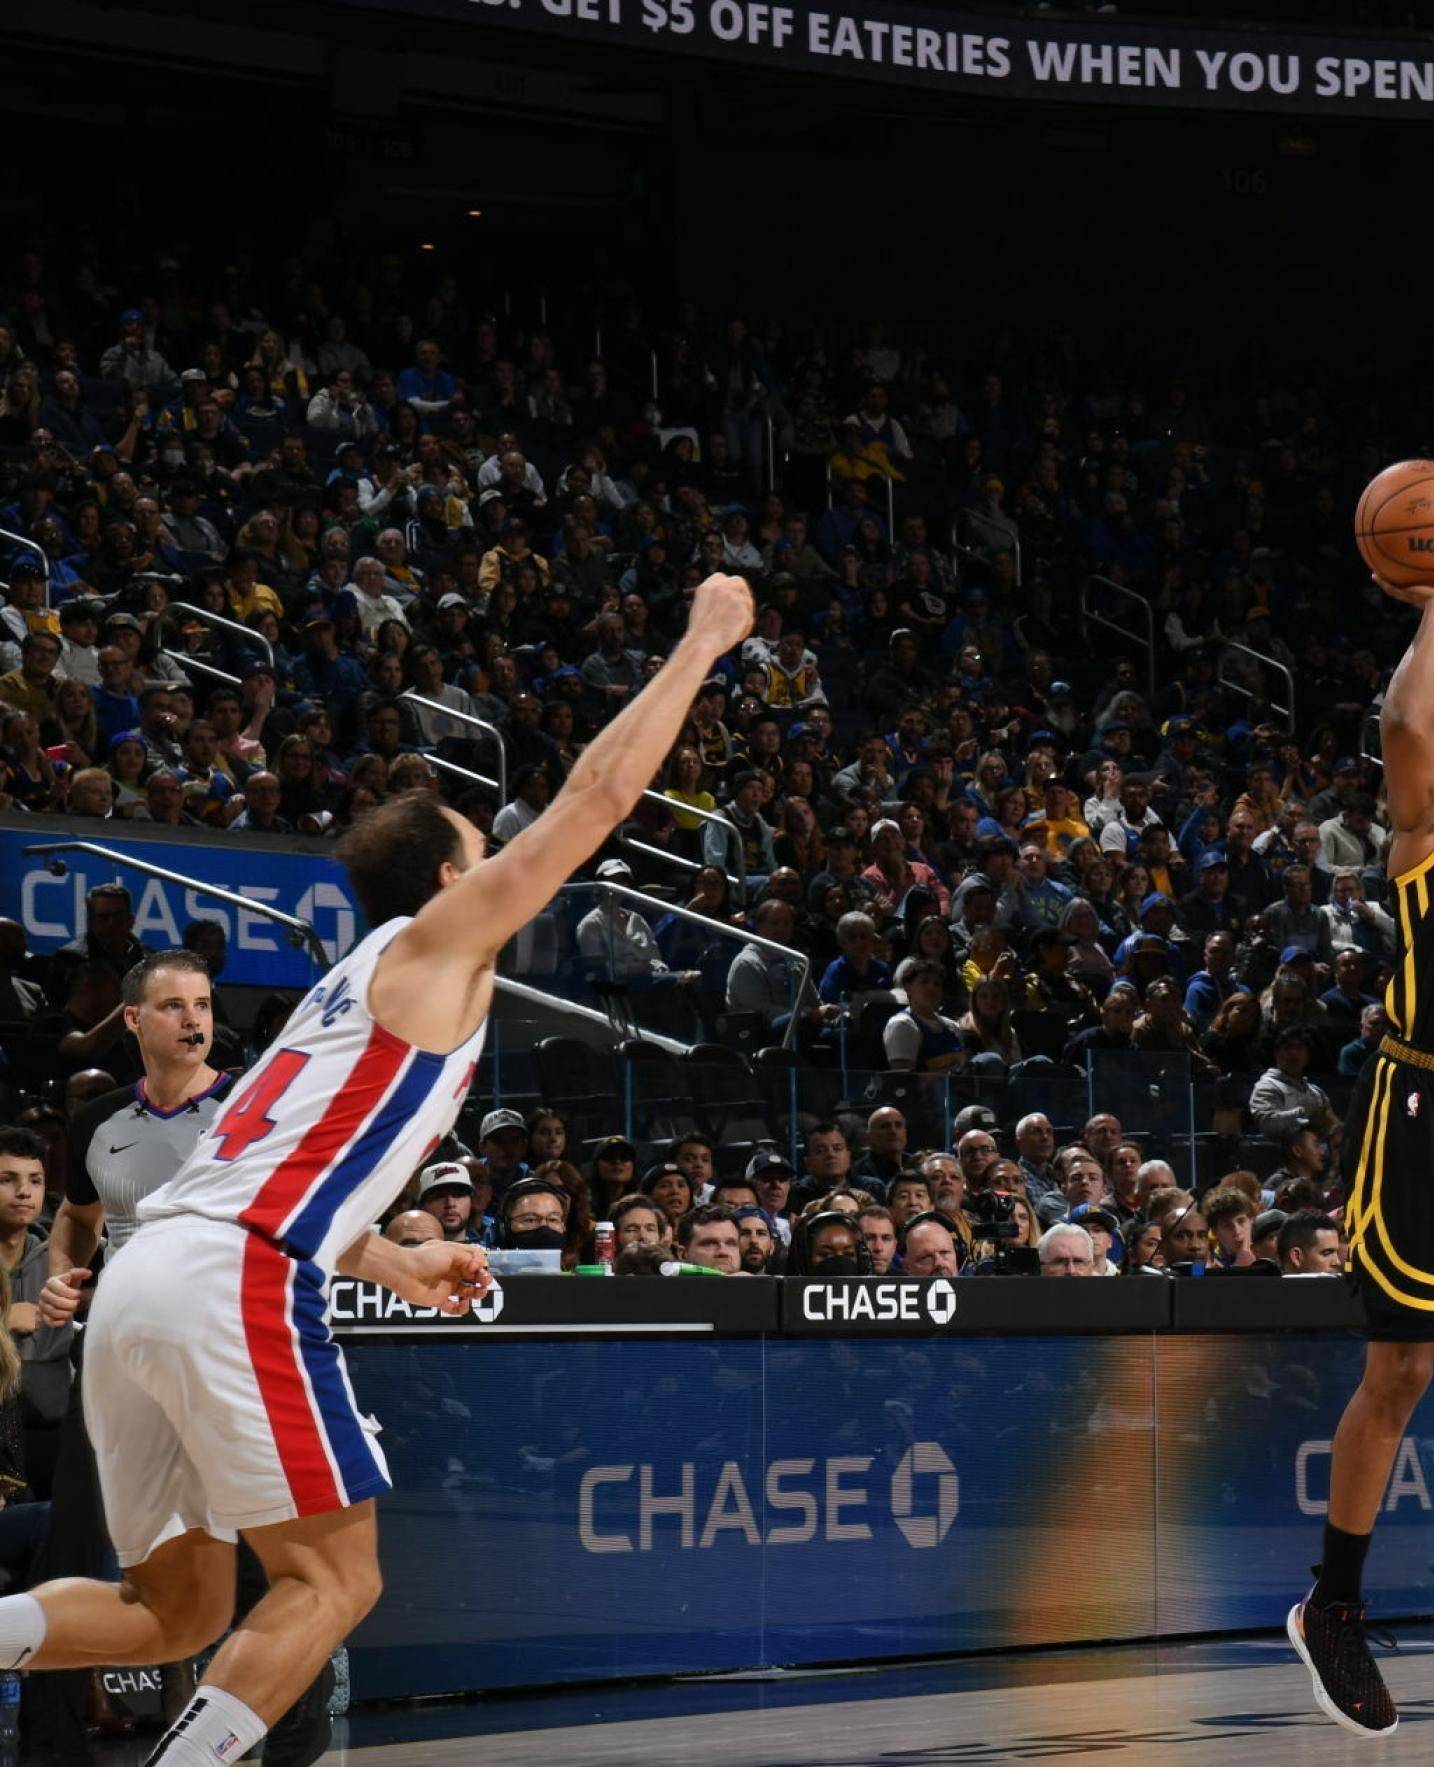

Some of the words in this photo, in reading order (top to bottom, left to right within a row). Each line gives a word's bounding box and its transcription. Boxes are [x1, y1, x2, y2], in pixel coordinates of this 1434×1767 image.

[642, 0, 695, 34] $5
[709, 0, 794, 47] OFF
[808, 12, 1010, 77] EATERIES
[1027, 40, 1182, 88] WHEN
[1196, 49, 1300, 95] YOU
[211, 1046, 313, 1162] 4
[330, 1281, 464, 1319] CHA
[802, 1283, 921, 1321] CHASE
[578, 1456, 875, 1554] CHASE
[103, 1669, 163, 1694] CHAS
